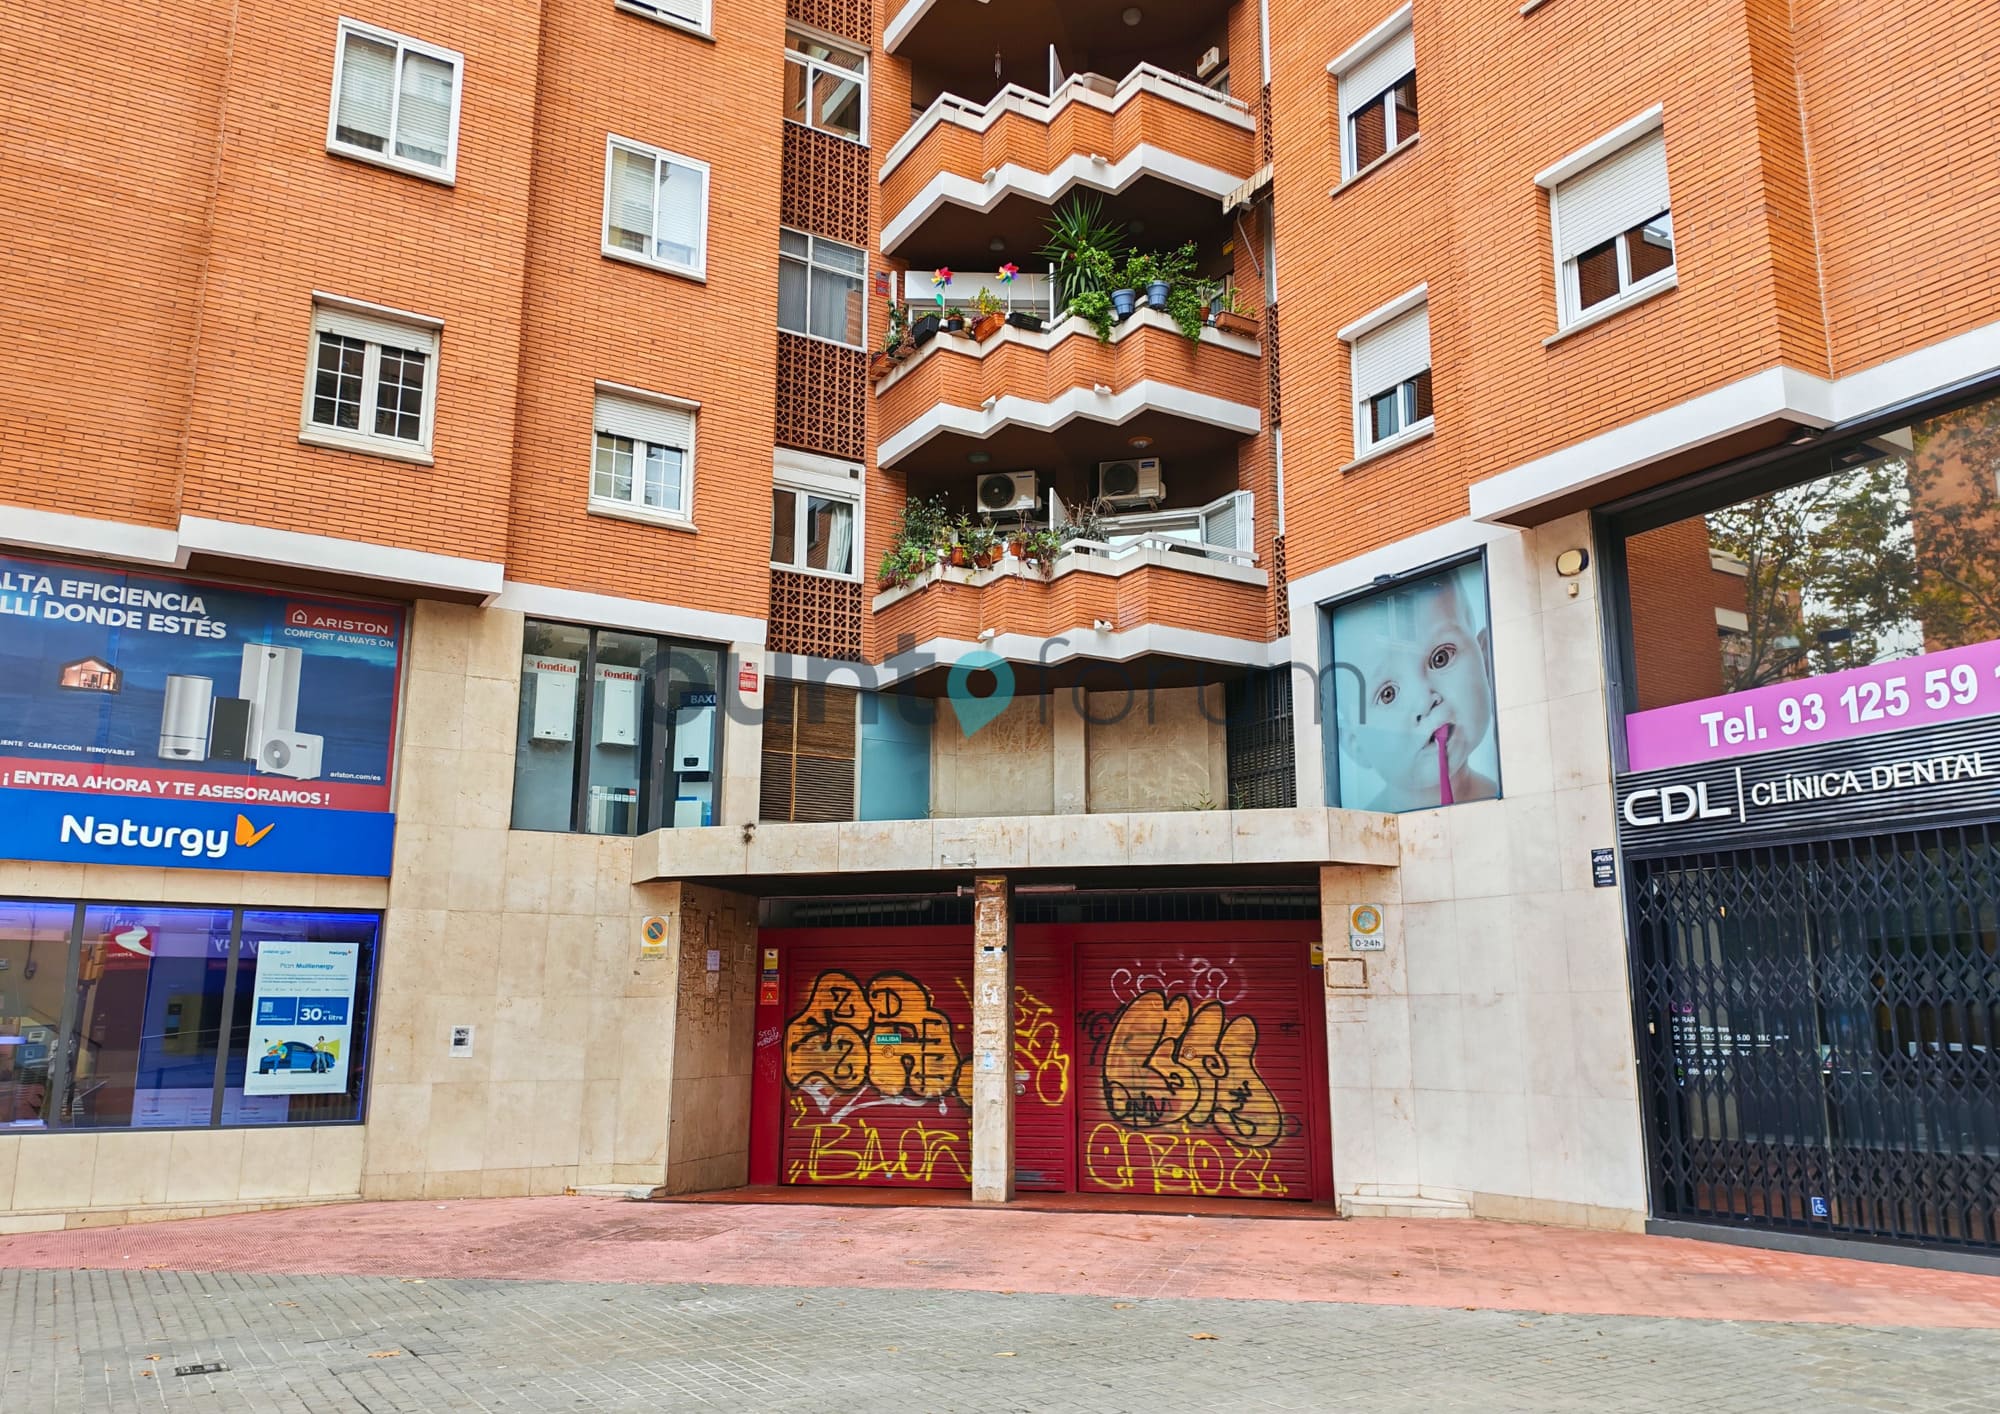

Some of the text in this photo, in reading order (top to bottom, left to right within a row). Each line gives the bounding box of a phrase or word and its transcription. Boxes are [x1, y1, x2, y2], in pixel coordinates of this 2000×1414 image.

[0, 572, 206, 615] LTA EFICIENCIA
[44, 600, 142, 629] DONDE
[148, 613, 227, 639] ESTÉS
[313, 617, 388, 634] ARISTON
[284, 628, 394, 648] COMFORT ALWAYS ON
[536, 660, 577, 673] fondital
[603, 668, 642, 681] fondital
[691, 694, 716, 705] BAXI
[1700, 664, 1978, 747] Tel. 93 125 59
[28, 741, 82, 752] CALEFACCIÓN
[86, 746, 136, 756] RENOVABLES
[330, 771, 381, 782] ariston.com/es
[13, 770, 79, 788] ENTRA
[82, 776, 153, 793] AHORA
[156, 781, 170, 795] Y
[173, 782, 195, 796] TE
[198, 784, 321, 804] ASESORAMOS
[1624, 752, 1994, 827] CDL CLÍNICA DENTAL
[60, 814, 229, 858] Naturgy
[1355, 939, 1381, 948] 0-24h
[300, 1008, 322, 1021] 30
[328, 1013, 344, 1021] litre
